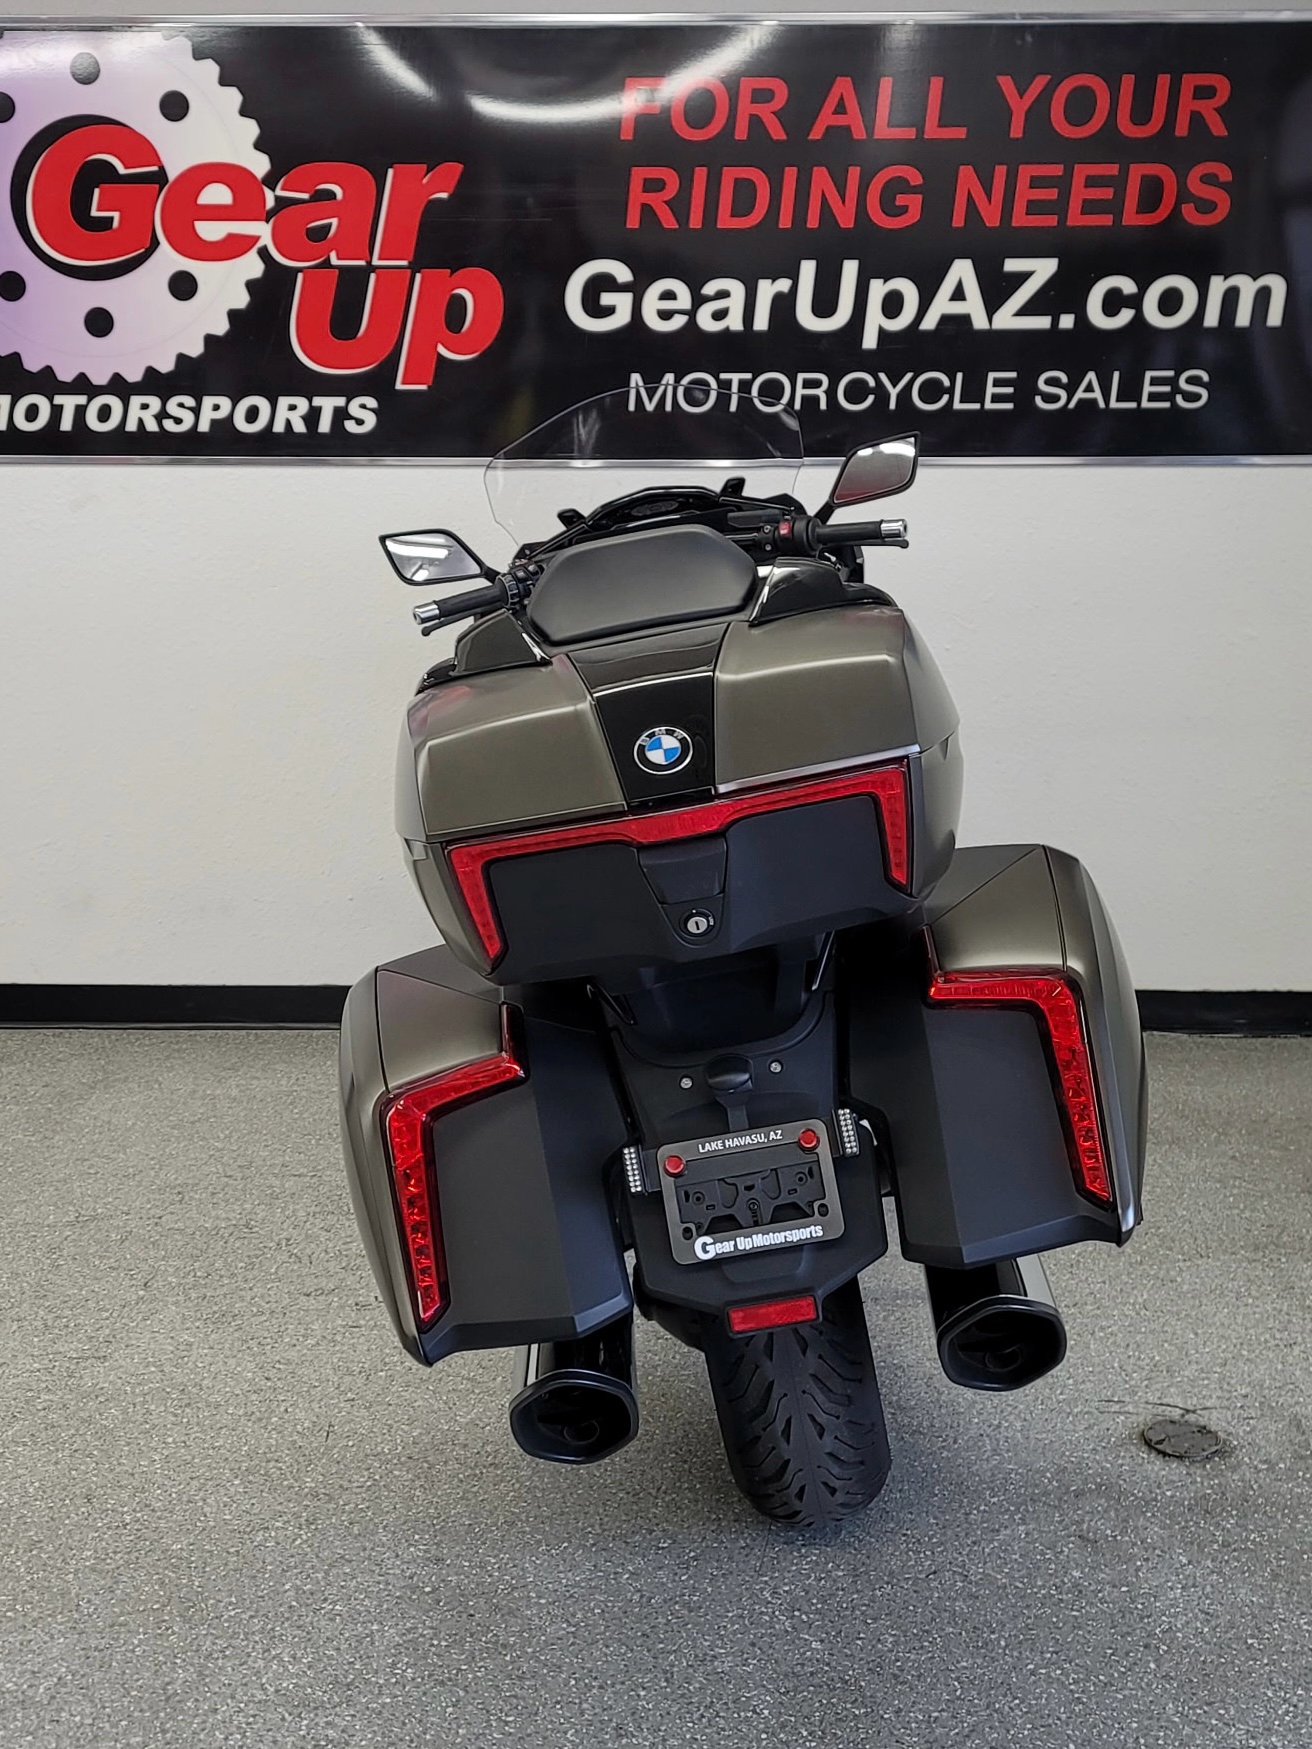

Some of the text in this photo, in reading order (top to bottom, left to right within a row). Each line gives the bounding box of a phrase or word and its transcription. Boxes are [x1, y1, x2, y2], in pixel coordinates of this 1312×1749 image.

[619, 73, 1231, 141] FOR ALL YOUR
[26, 124, 464, 266] Gear
[625, 162, 1233, 229] RIDING NEEDS
[564, 257, 1288, 350] GearUpAZ.com
[0, 394, 378, 433] OTORSPORTS
[627, 369, 1211, 413] MOTORCYCLE SALES
[699, 1130, 783, 1152] LAKE HAVASU, AZ
[694, 1225, 823, 1260] Gear Up Motorsports
